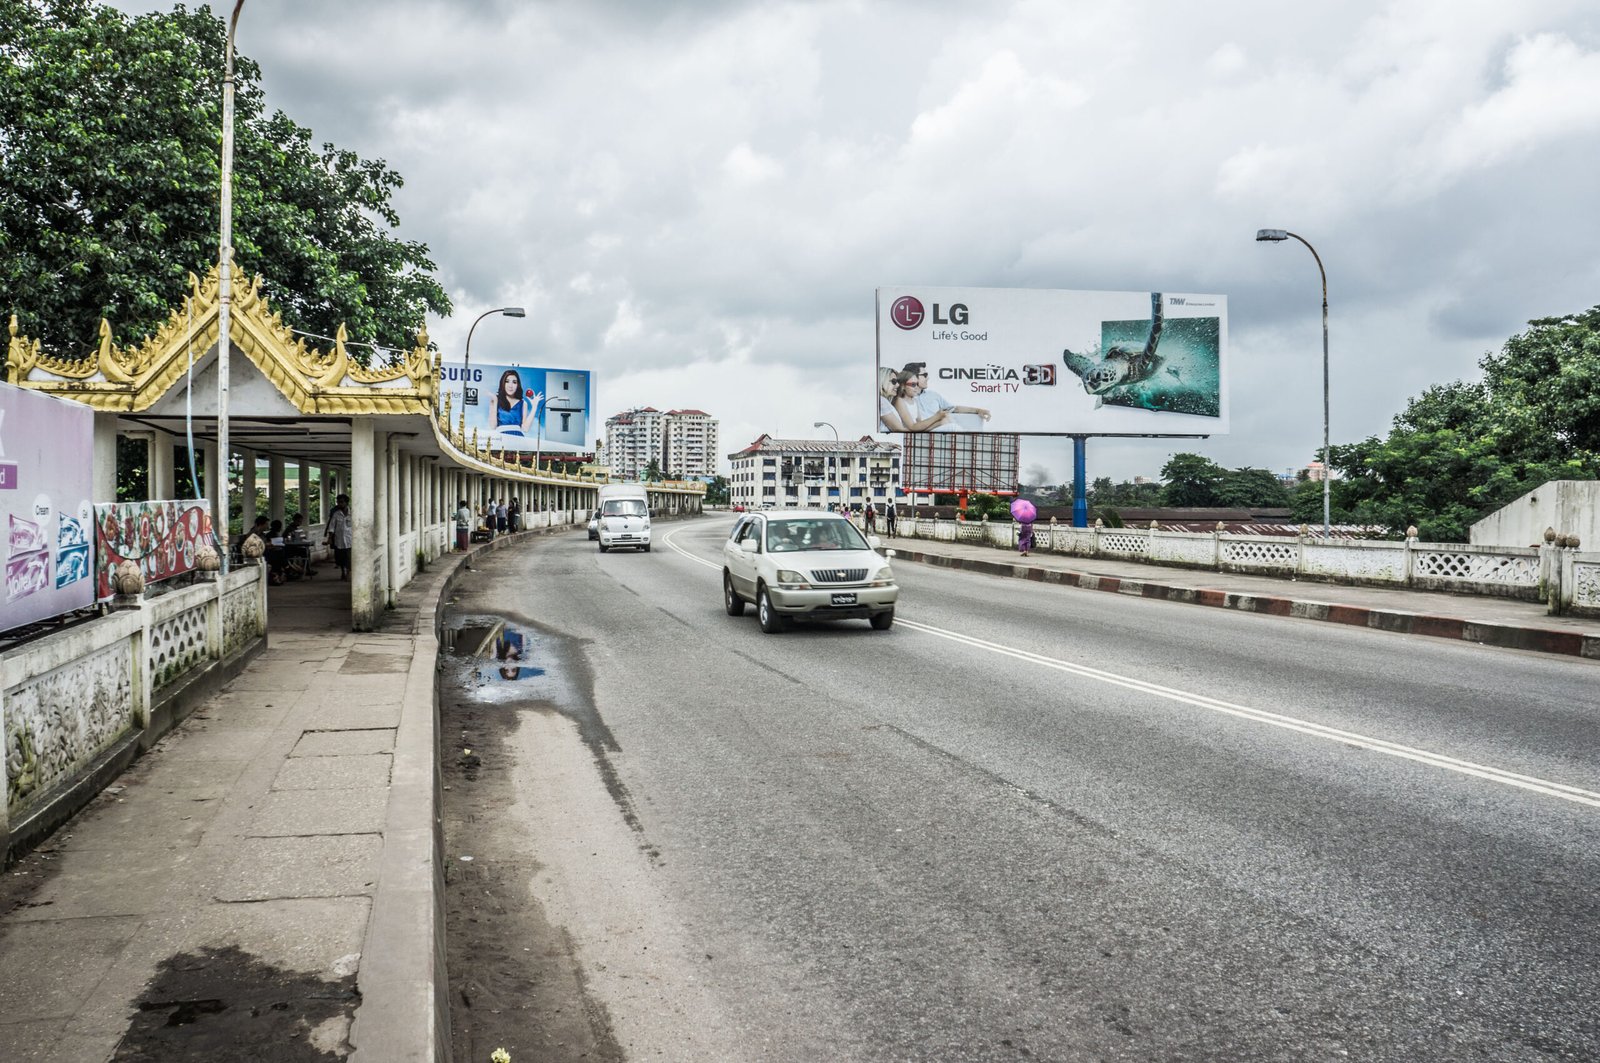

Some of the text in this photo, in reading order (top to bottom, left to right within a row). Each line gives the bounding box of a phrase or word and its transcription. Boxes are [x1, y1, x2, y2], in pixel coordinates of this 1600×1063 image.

[932, 303, 969, 325] LG
[932, 330, 988, 341] Life's Good
[939, 364, 1057, 386] CINEMA 3D
[466, 389, 477, 397] 10
[970, 382, 1020, 393] Smart TV
